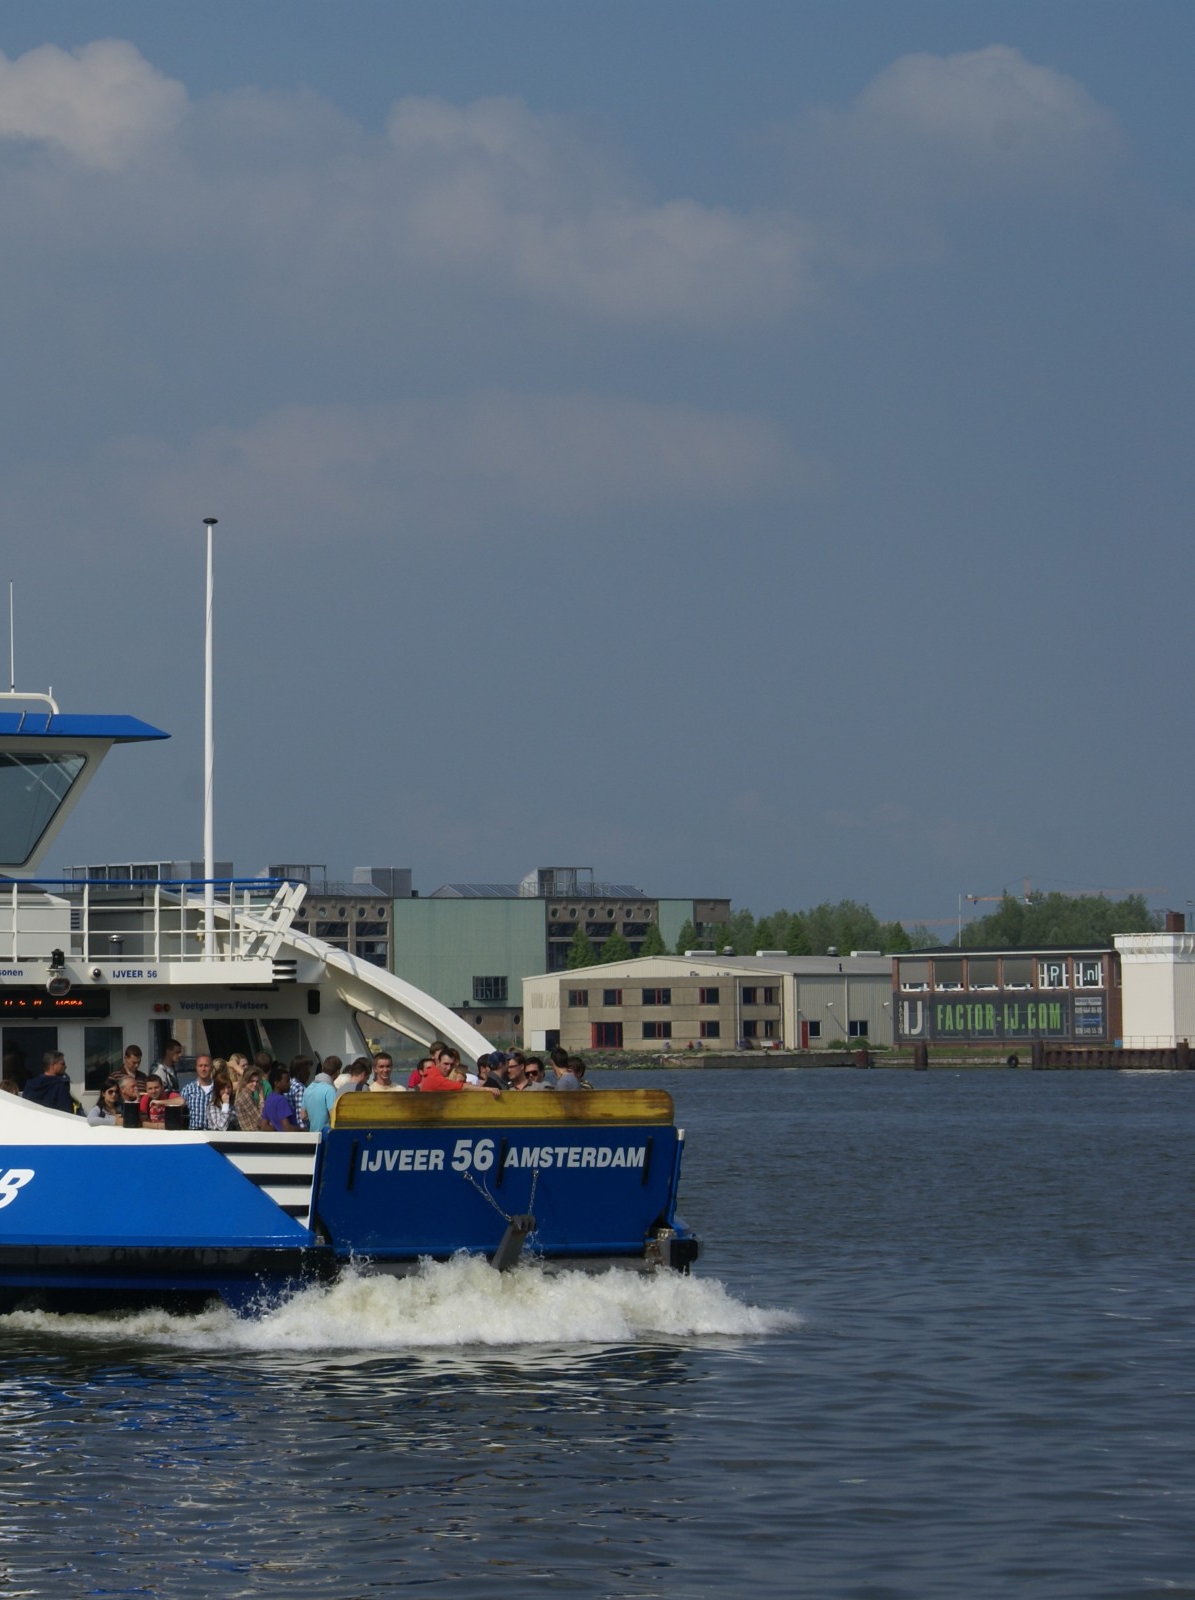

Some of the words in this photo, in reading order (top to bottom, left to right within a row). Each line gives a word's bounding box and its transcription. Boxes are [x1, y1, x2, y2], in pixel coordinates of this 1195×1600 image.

[112, 970, 144, 978] IJVEER
[147, 970, 158, 978] 56
[903, 1001, 923, 1035] IJ
[936, 1003, 1061, 1031] FACTOR-IJ.COM
[360, 1149, 445, 1171] IJVEER
[451, 1138, 495, 1172] 56
[504, 1146, 646, 1168] AMSTERDAM
